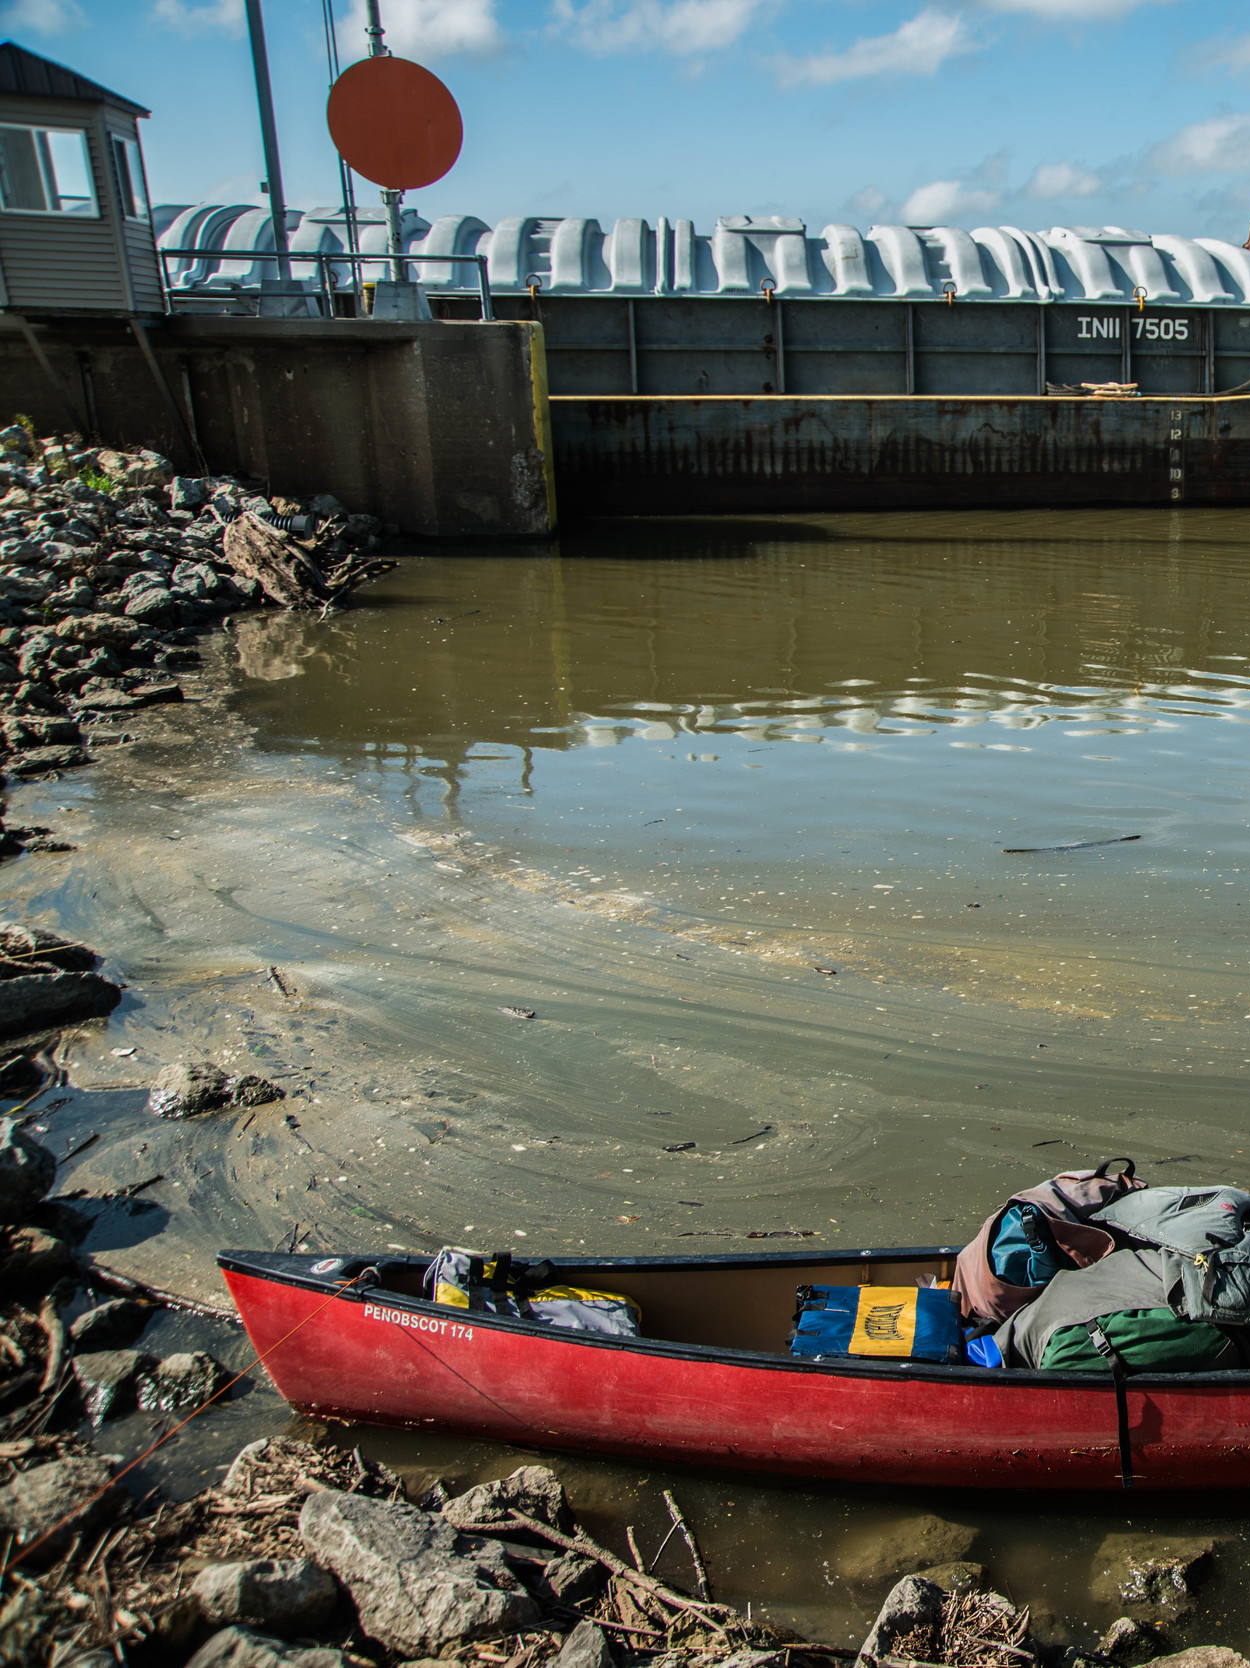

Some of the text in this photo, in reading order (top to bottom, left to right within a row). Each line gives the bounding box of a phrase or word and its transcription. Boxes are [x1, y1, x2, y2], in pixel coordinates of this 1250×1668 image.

[1131, 318, 1189, 340] 7505
[1170, 410, 1182, 421] 13
[1170, 429, 1182, 440] 12
[1169, 468, 1182, 481] 10
[364, 1304, 474, 1341] PENOBSCOT 174
